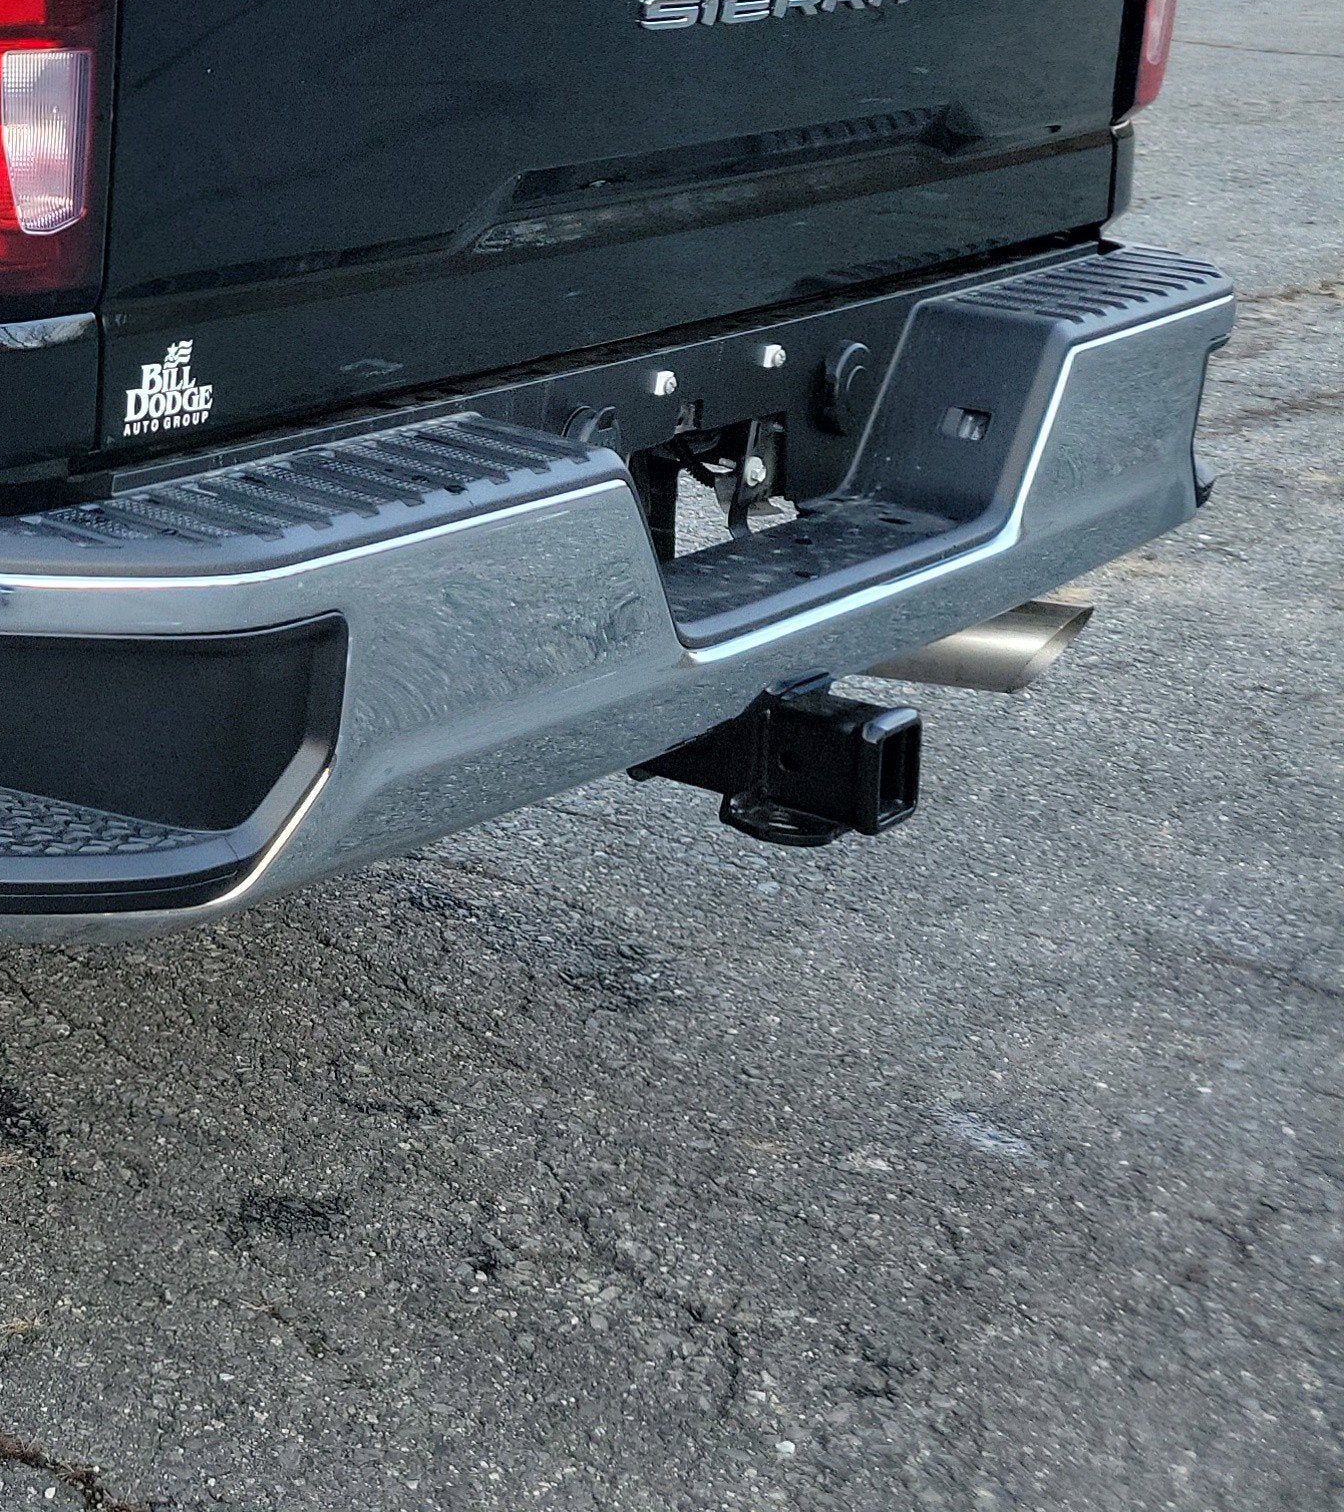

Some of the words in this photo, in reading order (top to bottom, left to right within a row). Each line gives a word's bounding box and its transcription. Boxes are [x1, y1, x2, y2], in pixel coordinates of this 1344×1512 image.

[124, 384, 212, 422] DODGE
[123, 419, 159, 437] AUTO
[163, 410, 209, 429] GROUP
